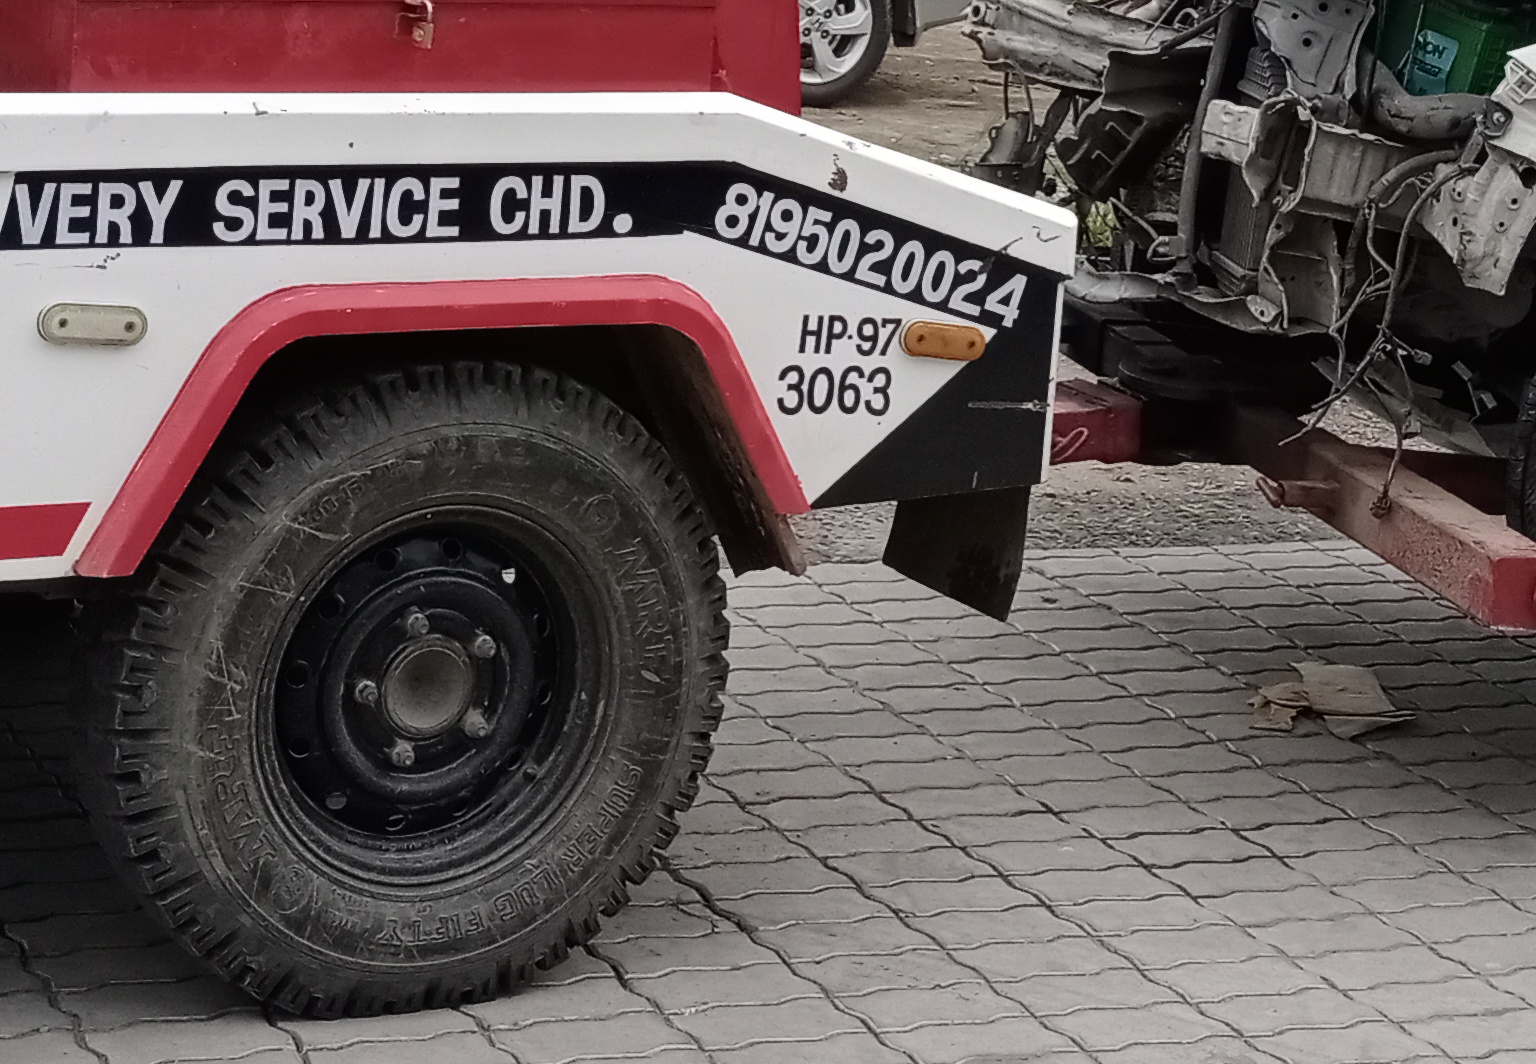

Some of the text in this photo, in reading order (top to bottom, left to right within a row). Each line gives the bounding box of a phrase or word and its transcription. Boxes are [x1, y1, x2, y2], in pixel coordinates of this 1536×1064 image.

[14, 179, 184, 245] VERY
[212, 176, 461, 243] SERVICE
[489, 174, 633, 235] CHD.
[714, 182, 1028, 328] 8195020024
[777, 364, 892, 417] 3063
[560, 760, 644, 874] SUPER
[493, 867, 563, 922] LUG
[375, 908, 486, 945] FIFTY
